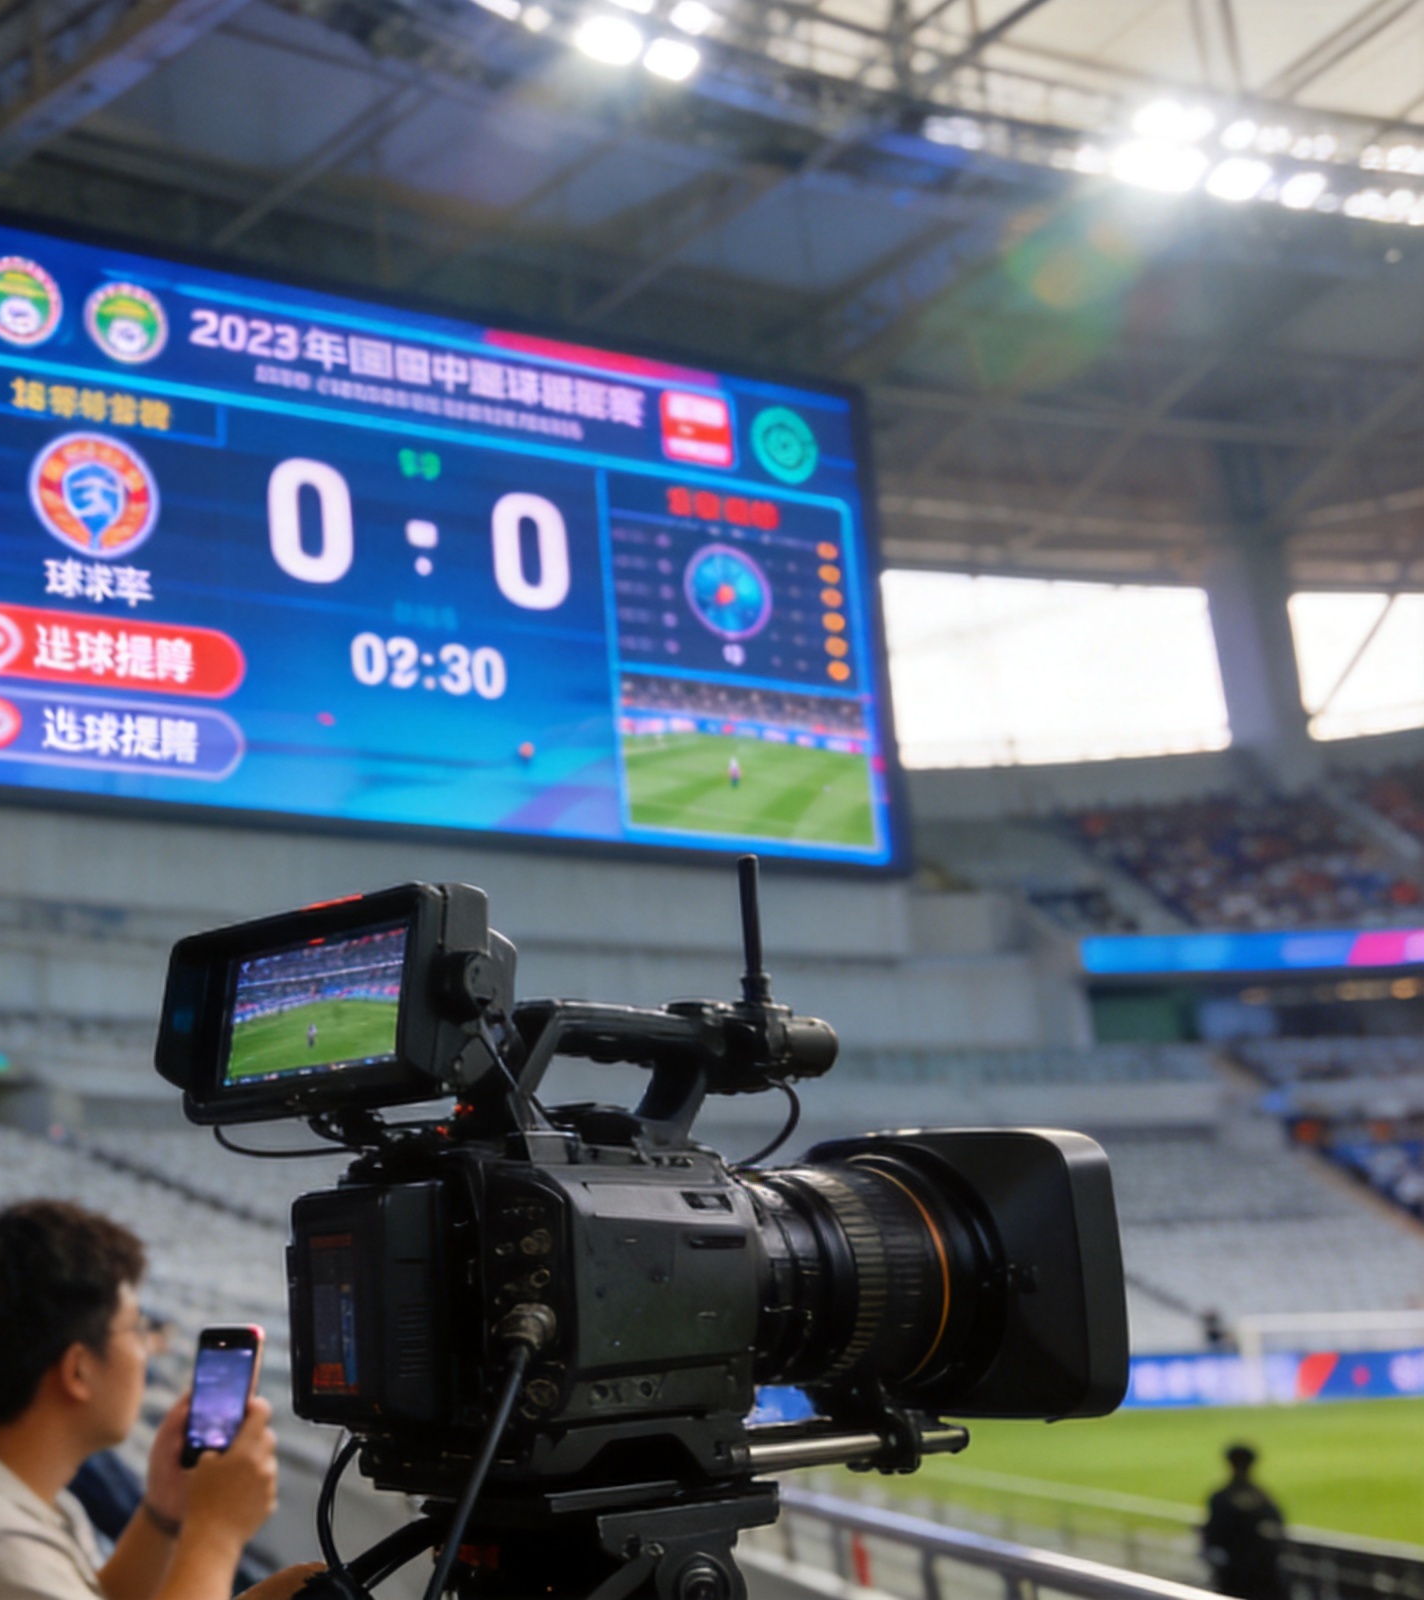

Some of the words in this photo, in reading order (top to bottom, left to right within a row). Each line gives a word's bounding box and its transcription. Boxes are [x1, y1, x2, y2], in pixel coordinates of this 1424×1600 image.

[267, 457, 354, 584] 0
[490, 491, 571, 611] 0
[349, 631, 507, 700] 02:30
